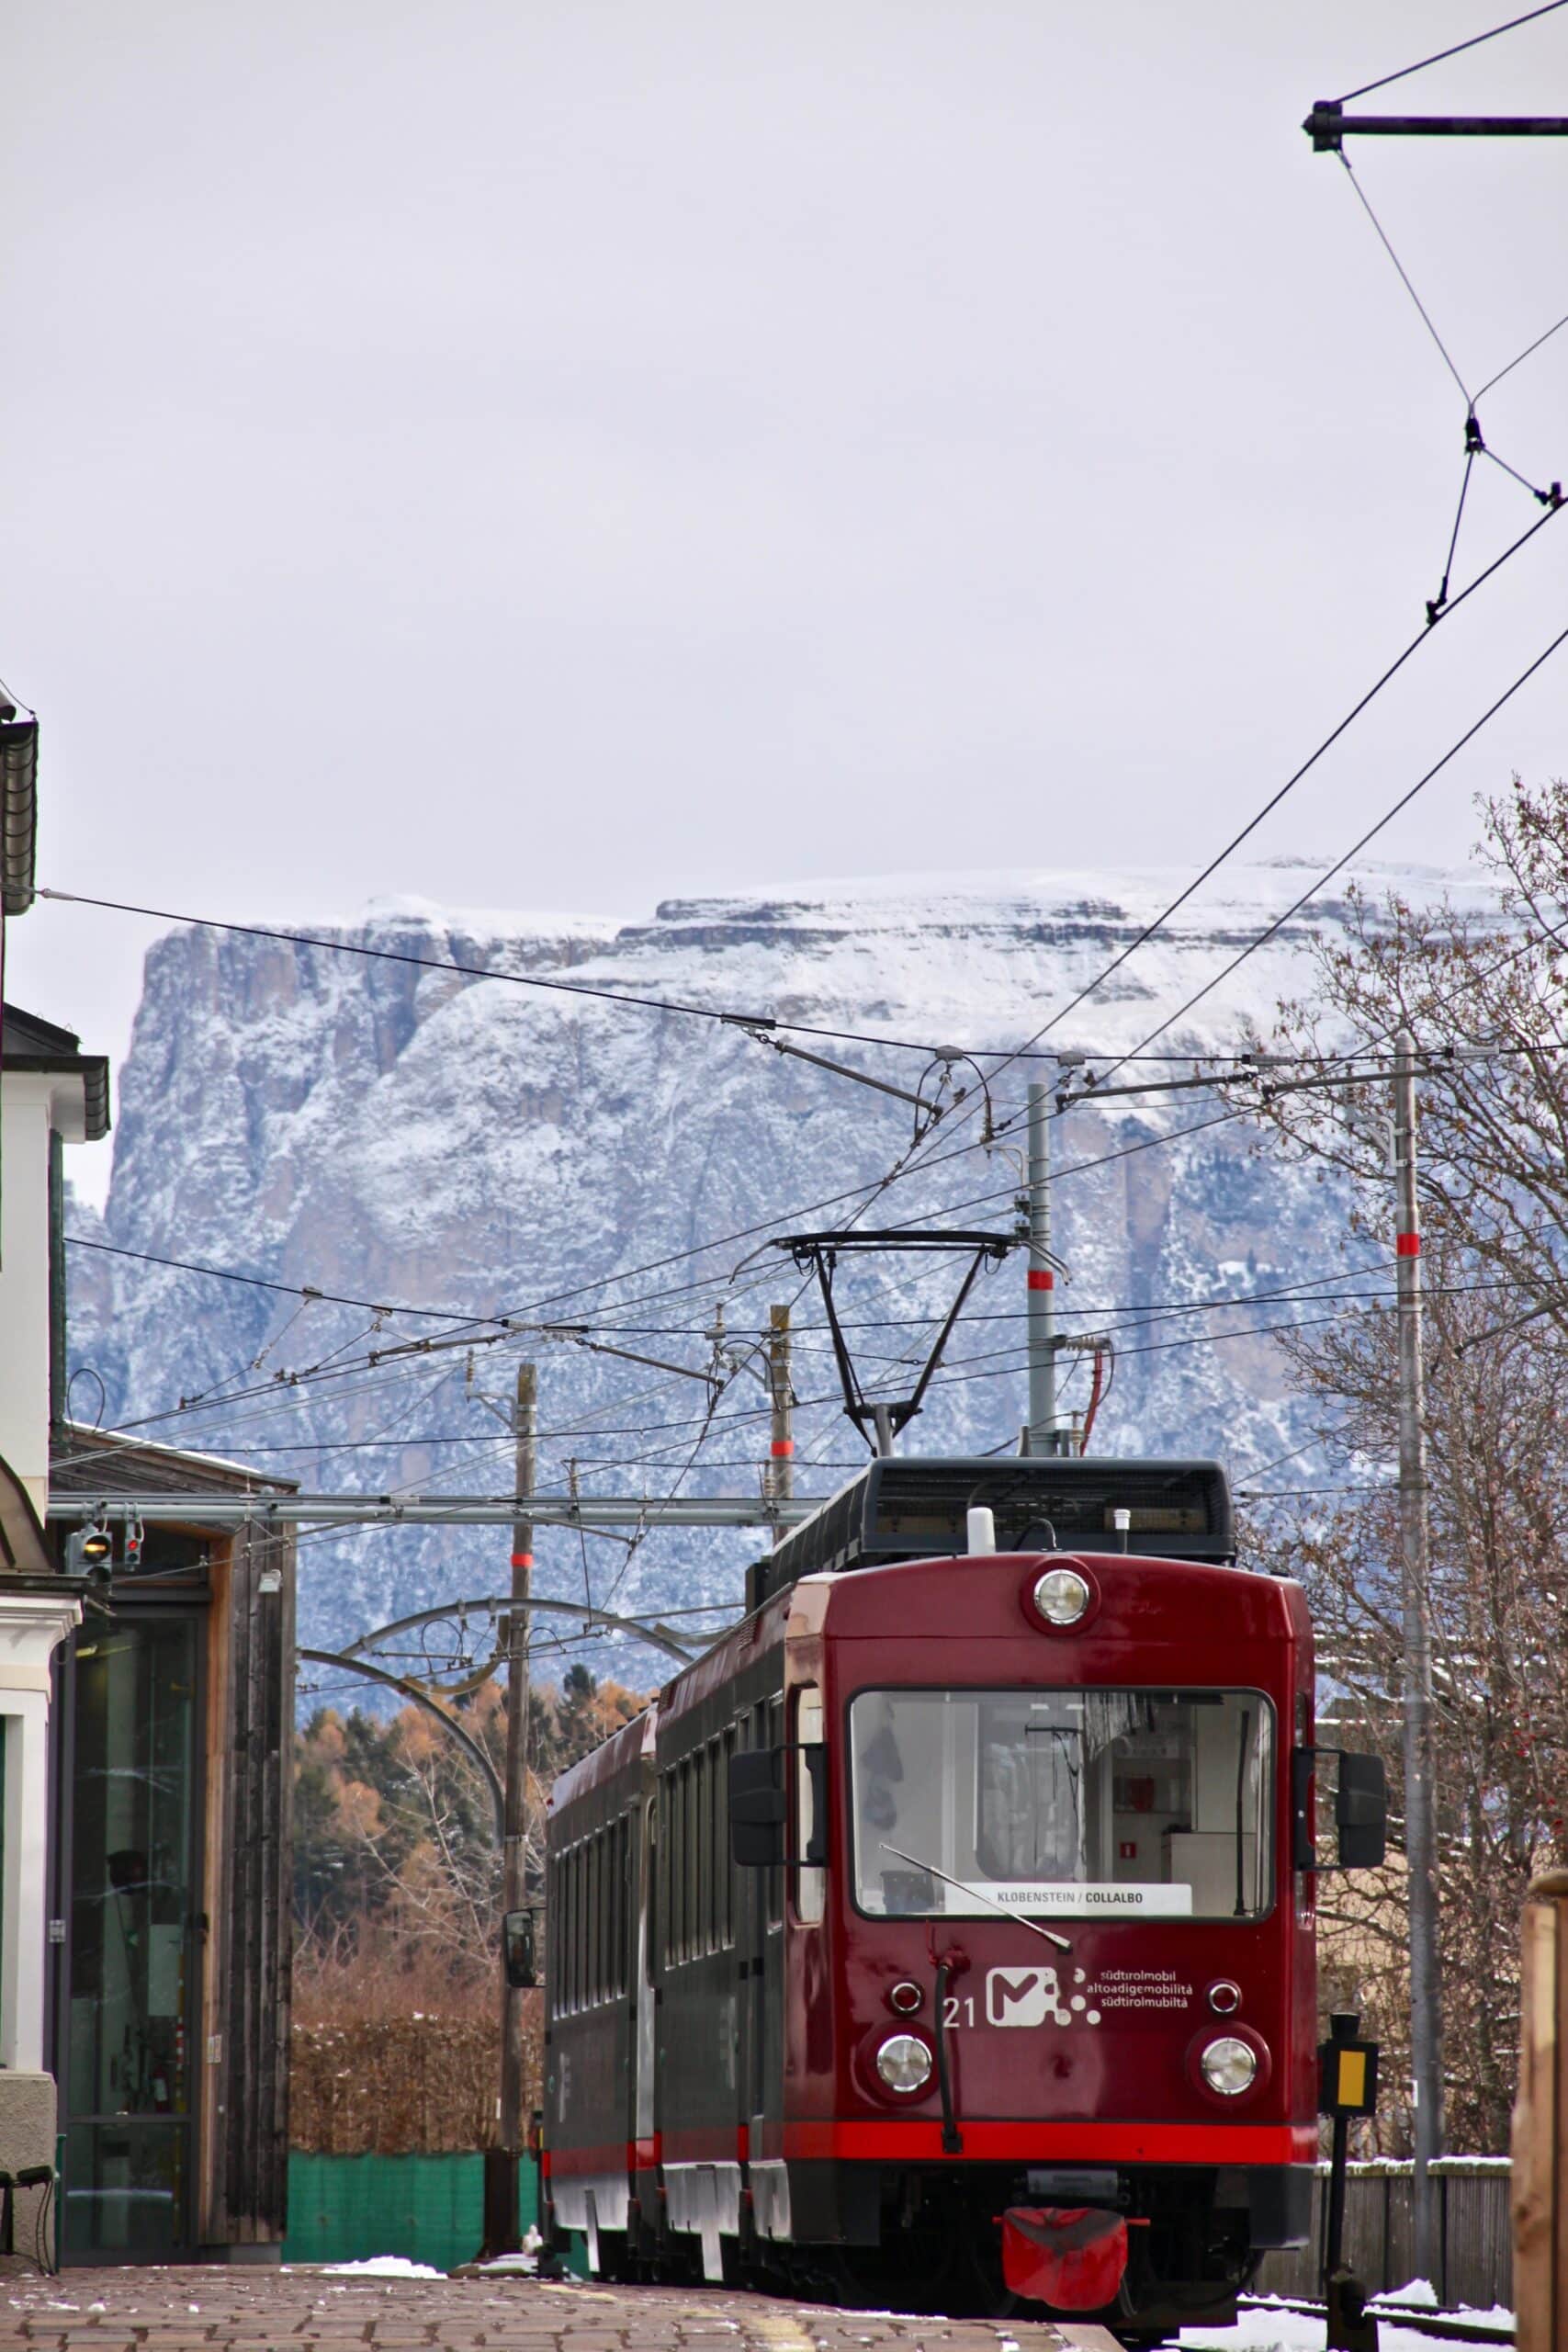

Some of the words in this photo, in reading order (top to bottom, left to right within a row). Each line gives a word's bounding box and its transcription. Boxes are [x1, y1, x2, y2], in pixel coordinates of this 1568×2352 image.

[998, 1892, 1075, 1903] KLOBENSTEIN
[1086, 1893, 1143, 1904] COLLALBO
[942, 1996, 975, 2028] 21
